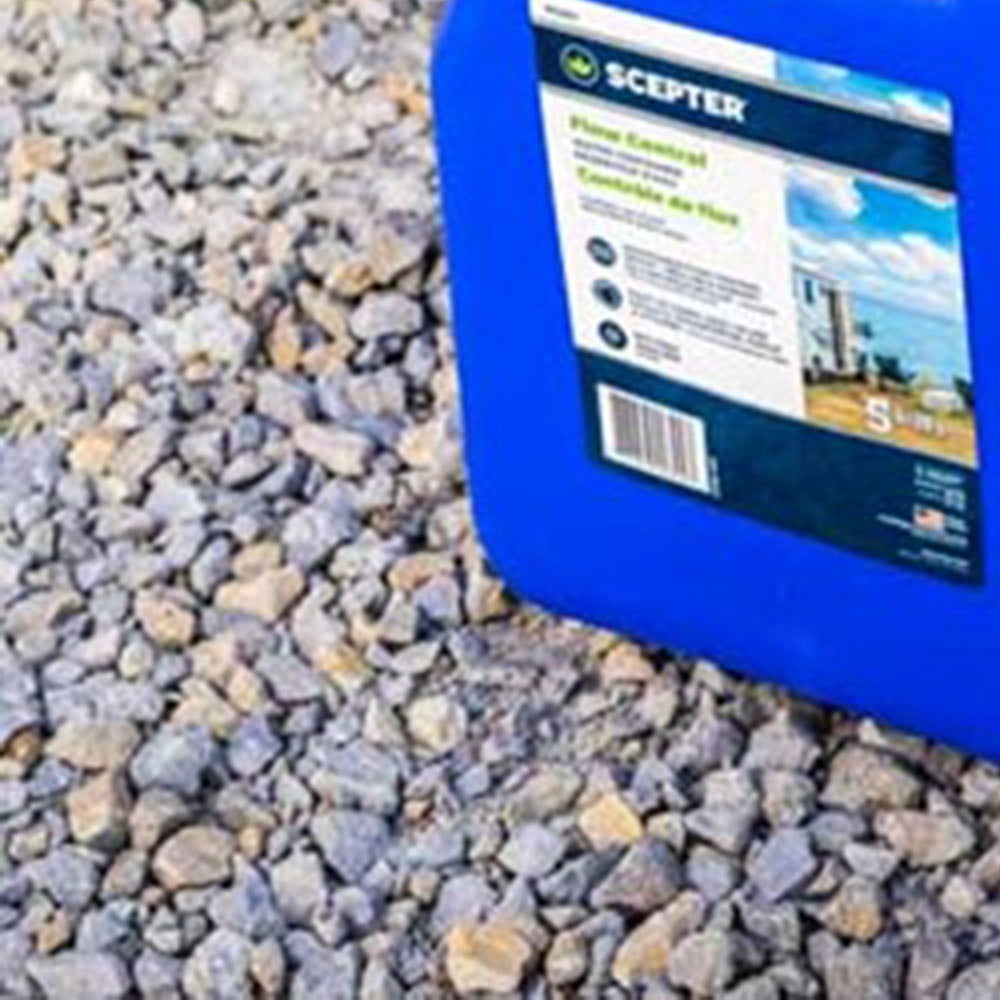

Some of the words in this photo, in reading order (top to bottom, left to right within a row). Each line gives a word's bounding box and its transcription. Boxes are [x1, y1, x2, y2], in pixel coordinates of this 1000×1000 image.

[604, 62, 747, 123] SCEPTER
[570, 114, 621, 142] Flow
[626, 131, 708, 169] Control
